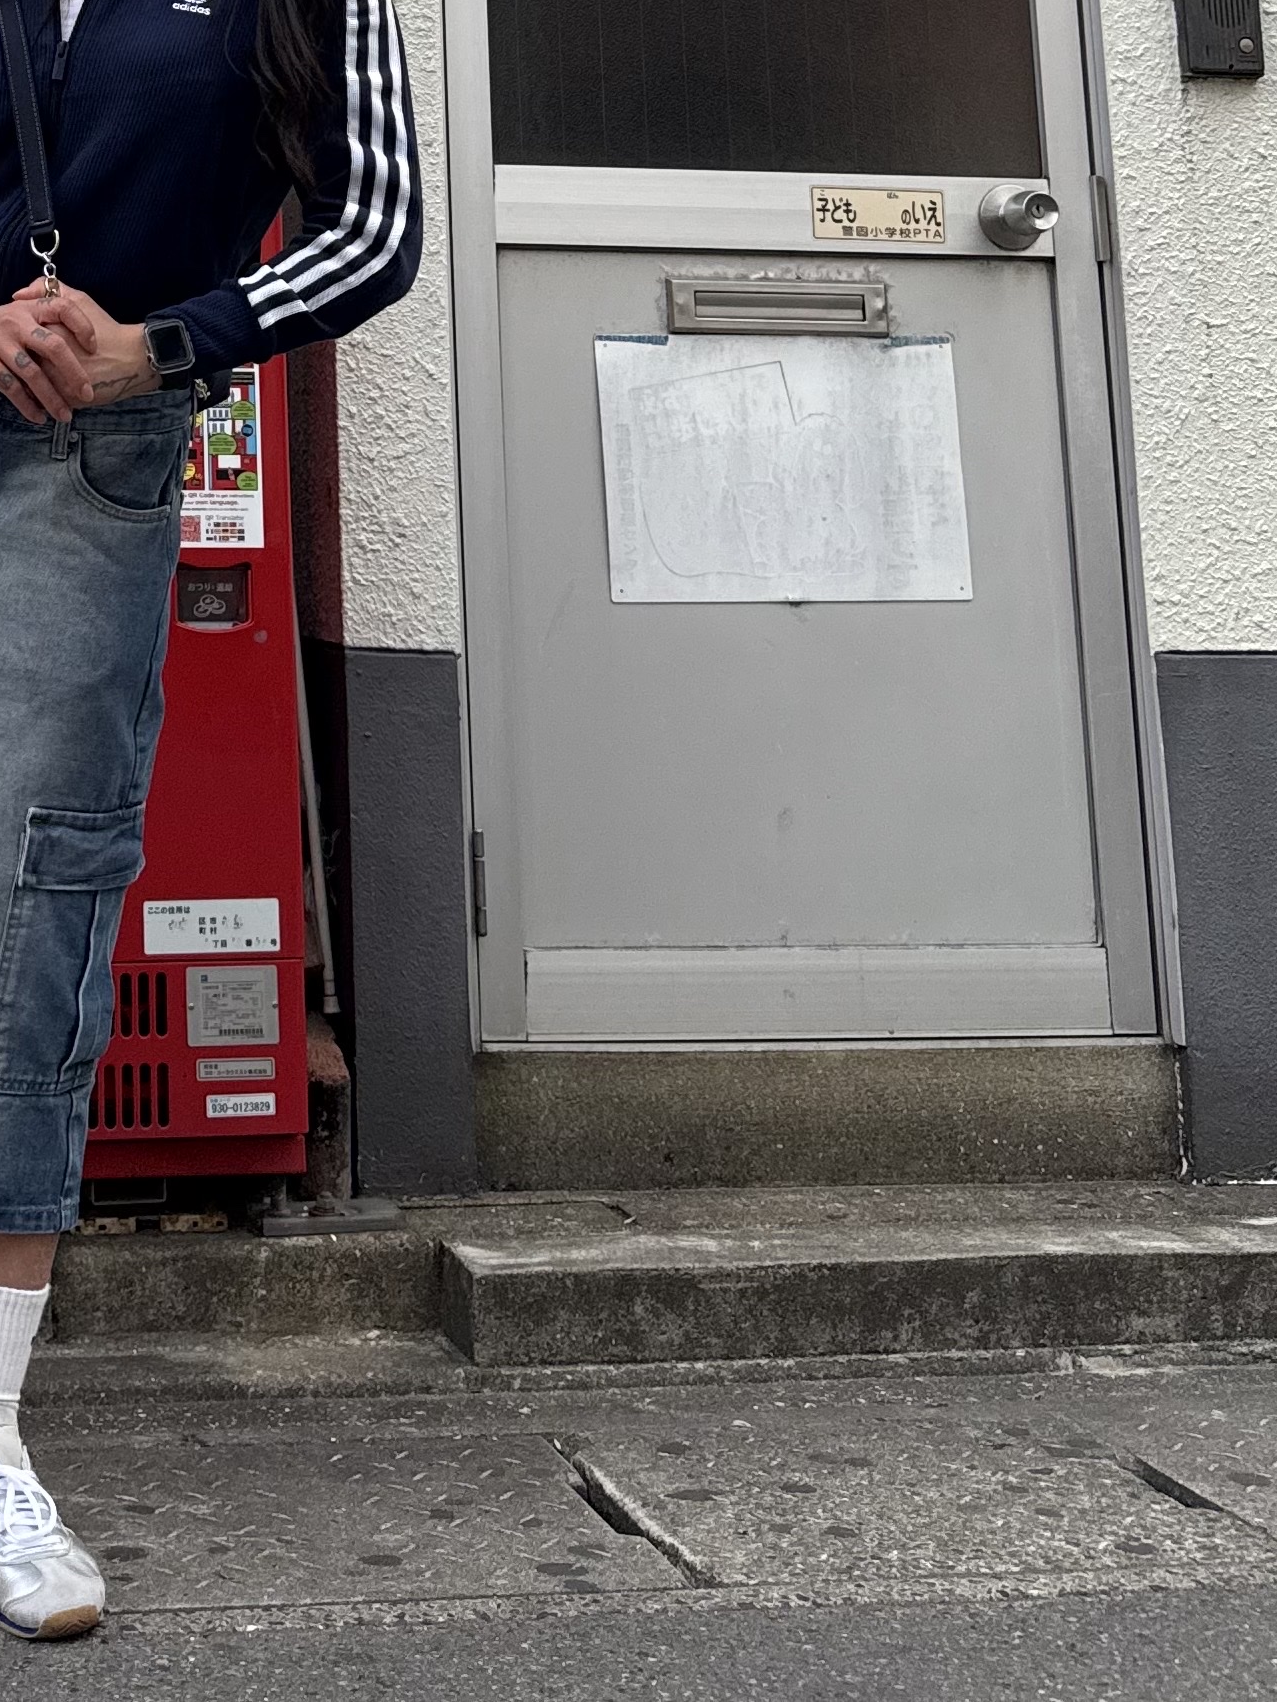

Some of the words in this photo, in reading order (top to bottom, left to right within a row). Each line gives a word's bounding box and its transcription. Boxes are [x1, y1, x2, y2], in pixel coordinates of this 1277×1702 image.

[172, 2, 211, 16] adidas
[816, 197, 857, 224] 子ども
[901, 199, 942, 227] のいえ
[147, 906, 191, 914] ここの住所は
[211, 1101, 271, 1114] 930-0123829
